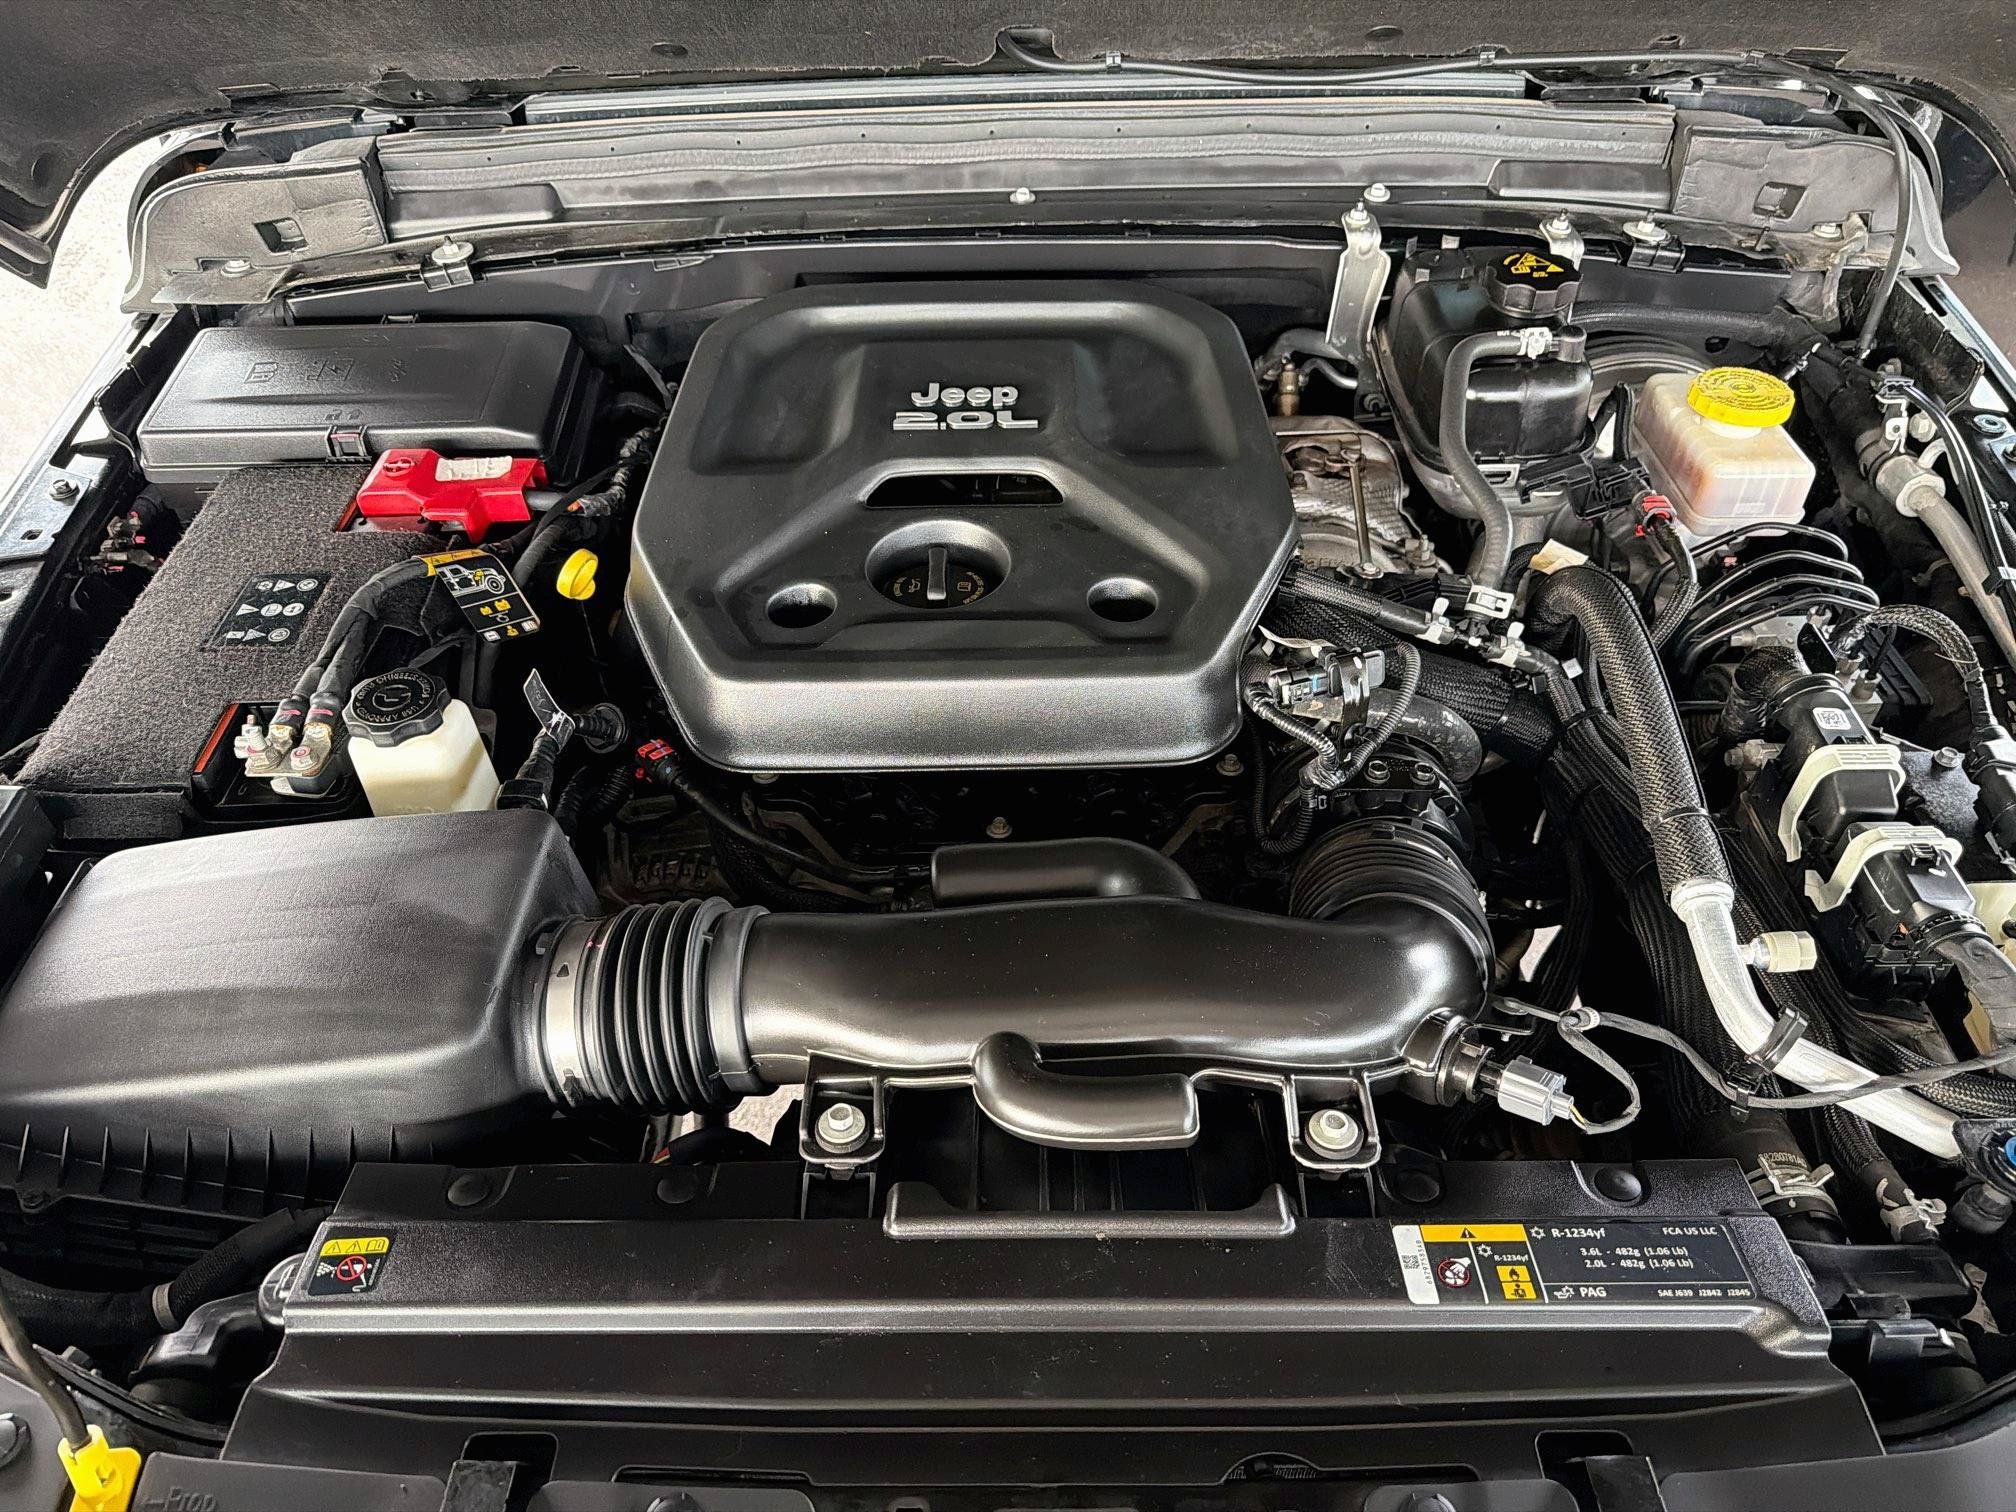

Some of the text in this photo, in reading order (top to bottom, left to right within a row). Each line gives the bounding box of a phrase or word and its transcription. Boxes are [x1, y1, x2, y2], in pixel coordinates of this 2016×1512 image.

[911, 382, 1019, 409] Jeep
[893, 410, 1039, 430] 2.0L
[1551, 1227, 1606, 1239] R-1234yf
[1662, 1227, 1718, 1236] FCA US LLC
[1580, 1247, 1602, 1256] 3.6L
[1615, 1247, 1641, 1258] 482g
[1644, 1246, 1671, 1257] (1.06
[1673, 1246, 1689, 1257] Lb)
[1494, 1254, 1529, 1263] R-1234yf
[1585, 1259, 1607, 1268] 2.0L
[1620, 1259, 1646, 1270] 482g
[1649, 1258, 1676, 1269] (1.06
[1678, 1258, 1694, 1269] Lb)
[1580, 1287, 1607, 1298] PAG
[1657, 1289, 1674, 1297] SAE
